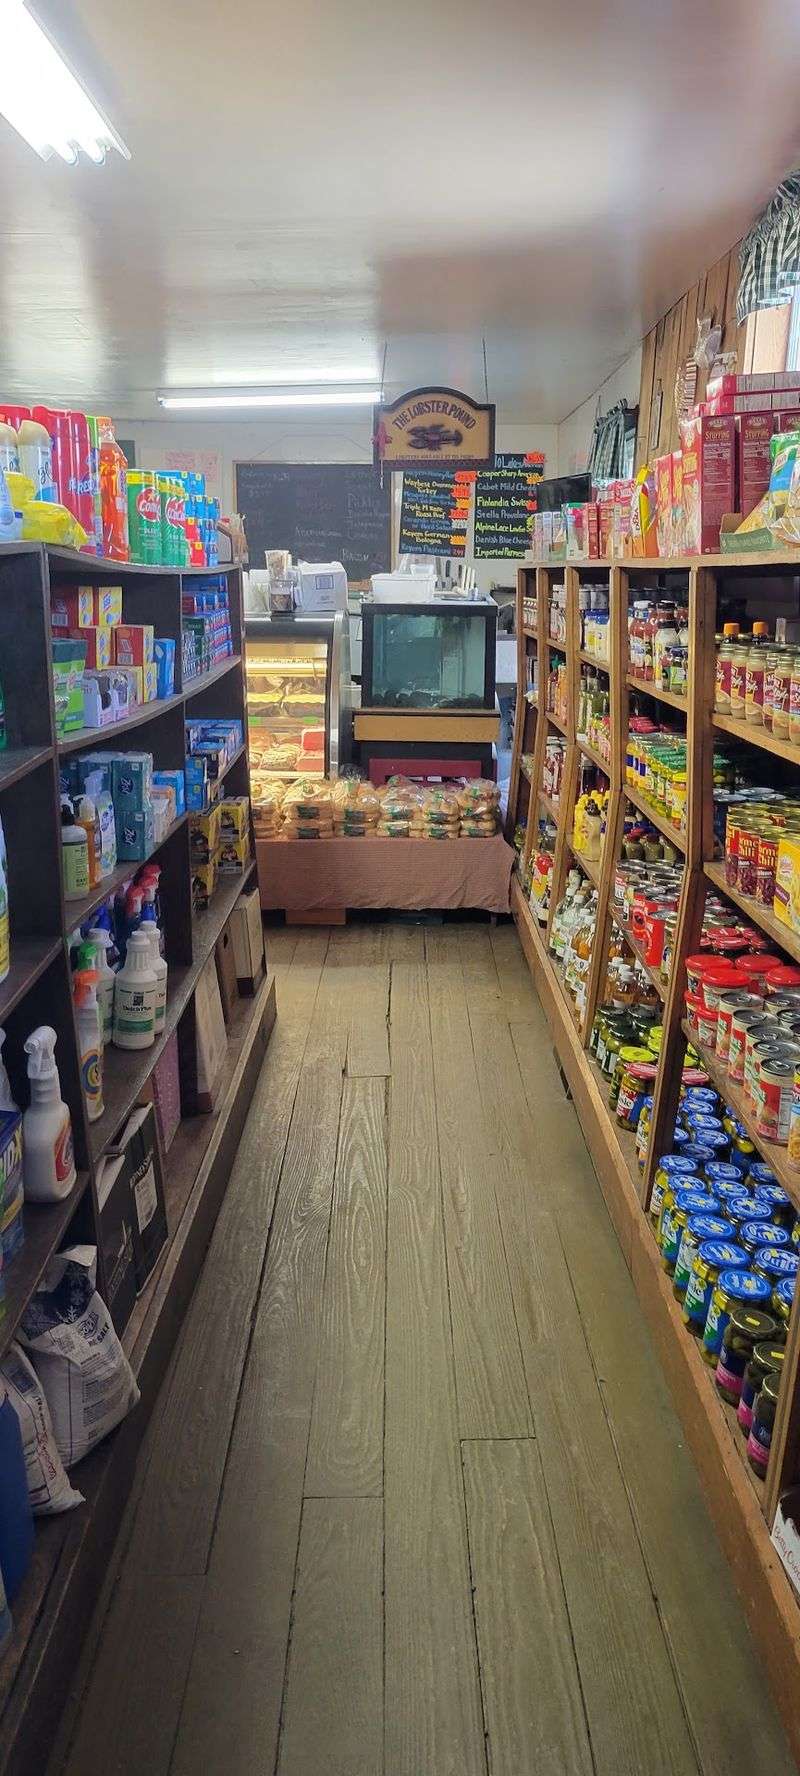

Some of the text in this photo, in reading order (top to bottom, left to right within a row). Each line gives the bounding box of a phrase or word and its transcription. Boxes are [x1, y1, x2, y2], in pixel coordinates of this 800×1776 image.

[392, 400, 476, 430] THE LOBSTER POUND
[477, 470, 501, 480] Cooper
[502, 470, 516, 479] Sharp
[476, 482, 499, 491] Cabot
[500, 482, 515, 491] Mild
[477, 496, 510, 507] Finlandia
[476, 510, 500, 519] Stella
[475, 521, 495, 534] Alpine
[495, 523, 509, 532] Lace
[475, 535, 499, 544] Danish
[499, 536, 512, 544] Blue
[475, 546, 504, 558] Imported
[96, 1321, 111, 1343] SALT
